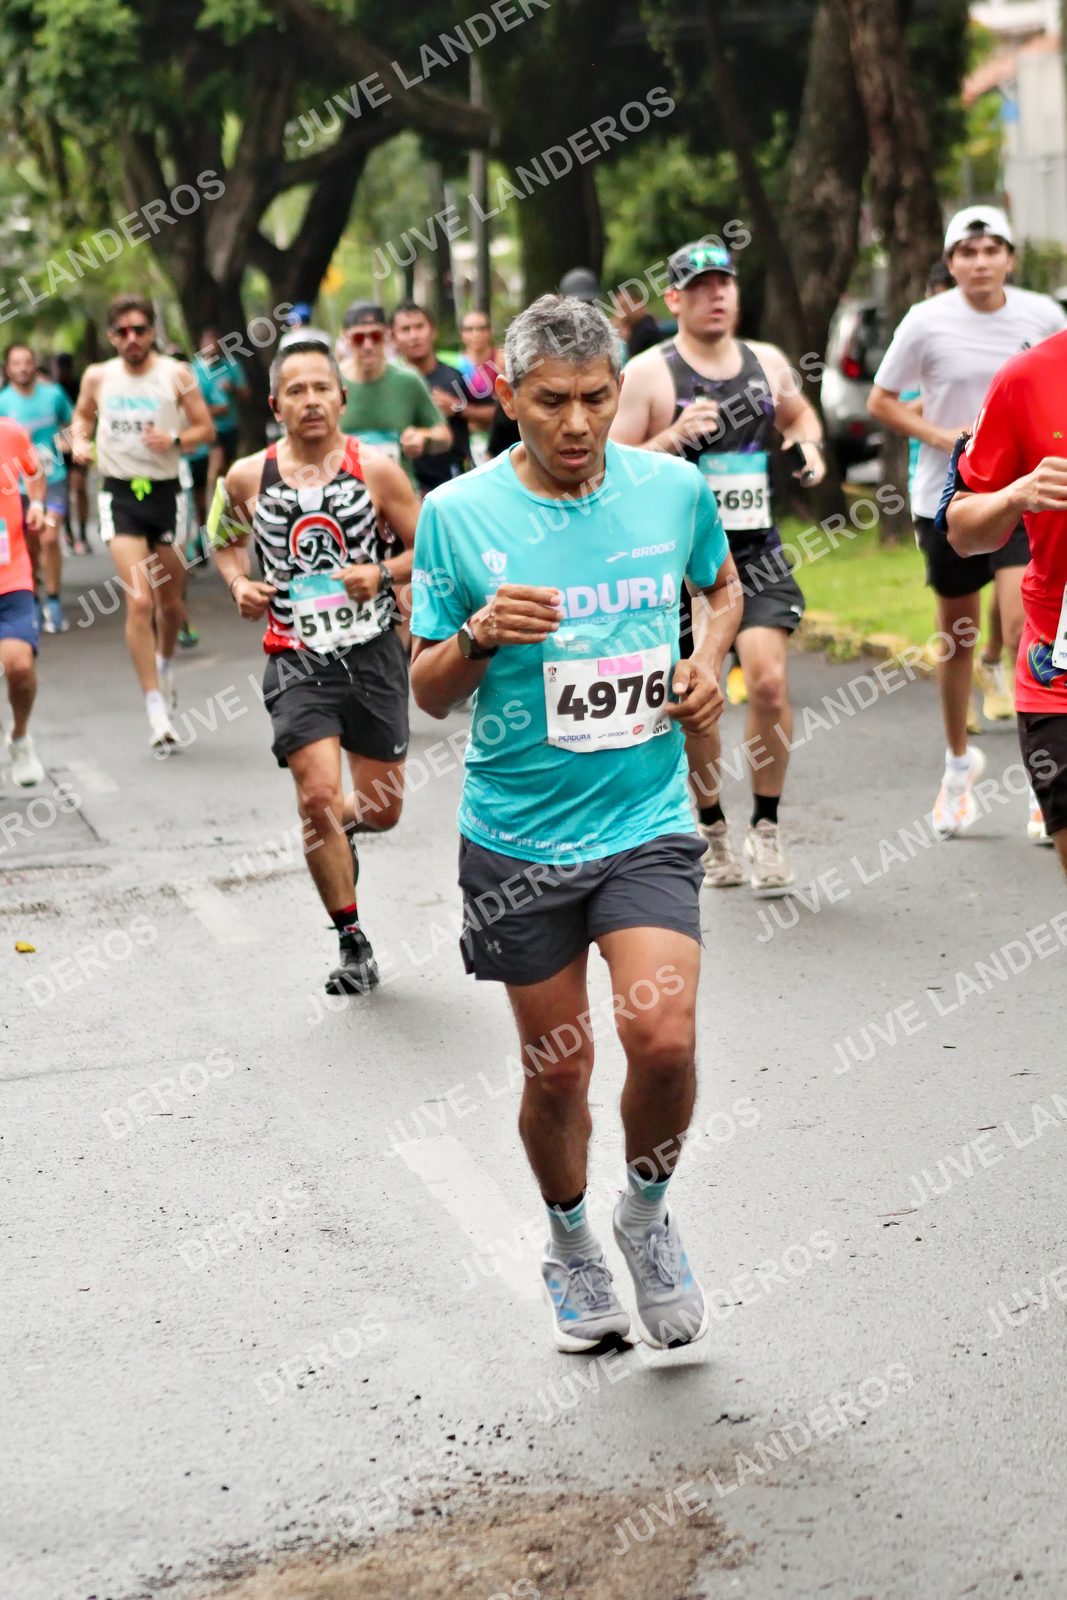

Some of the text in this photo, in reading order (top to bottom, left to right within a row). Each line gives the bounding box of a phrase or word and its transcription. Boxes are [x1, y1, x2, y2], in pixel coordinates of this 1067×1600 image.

[631, 540, 677, 559] BROOKS
[550, 573, 677, 620] DURA
[299, 601, 372, 638] 5194
[557, 670, 665, 721] 4976
[558, 733, 592, 742] PERDURA
